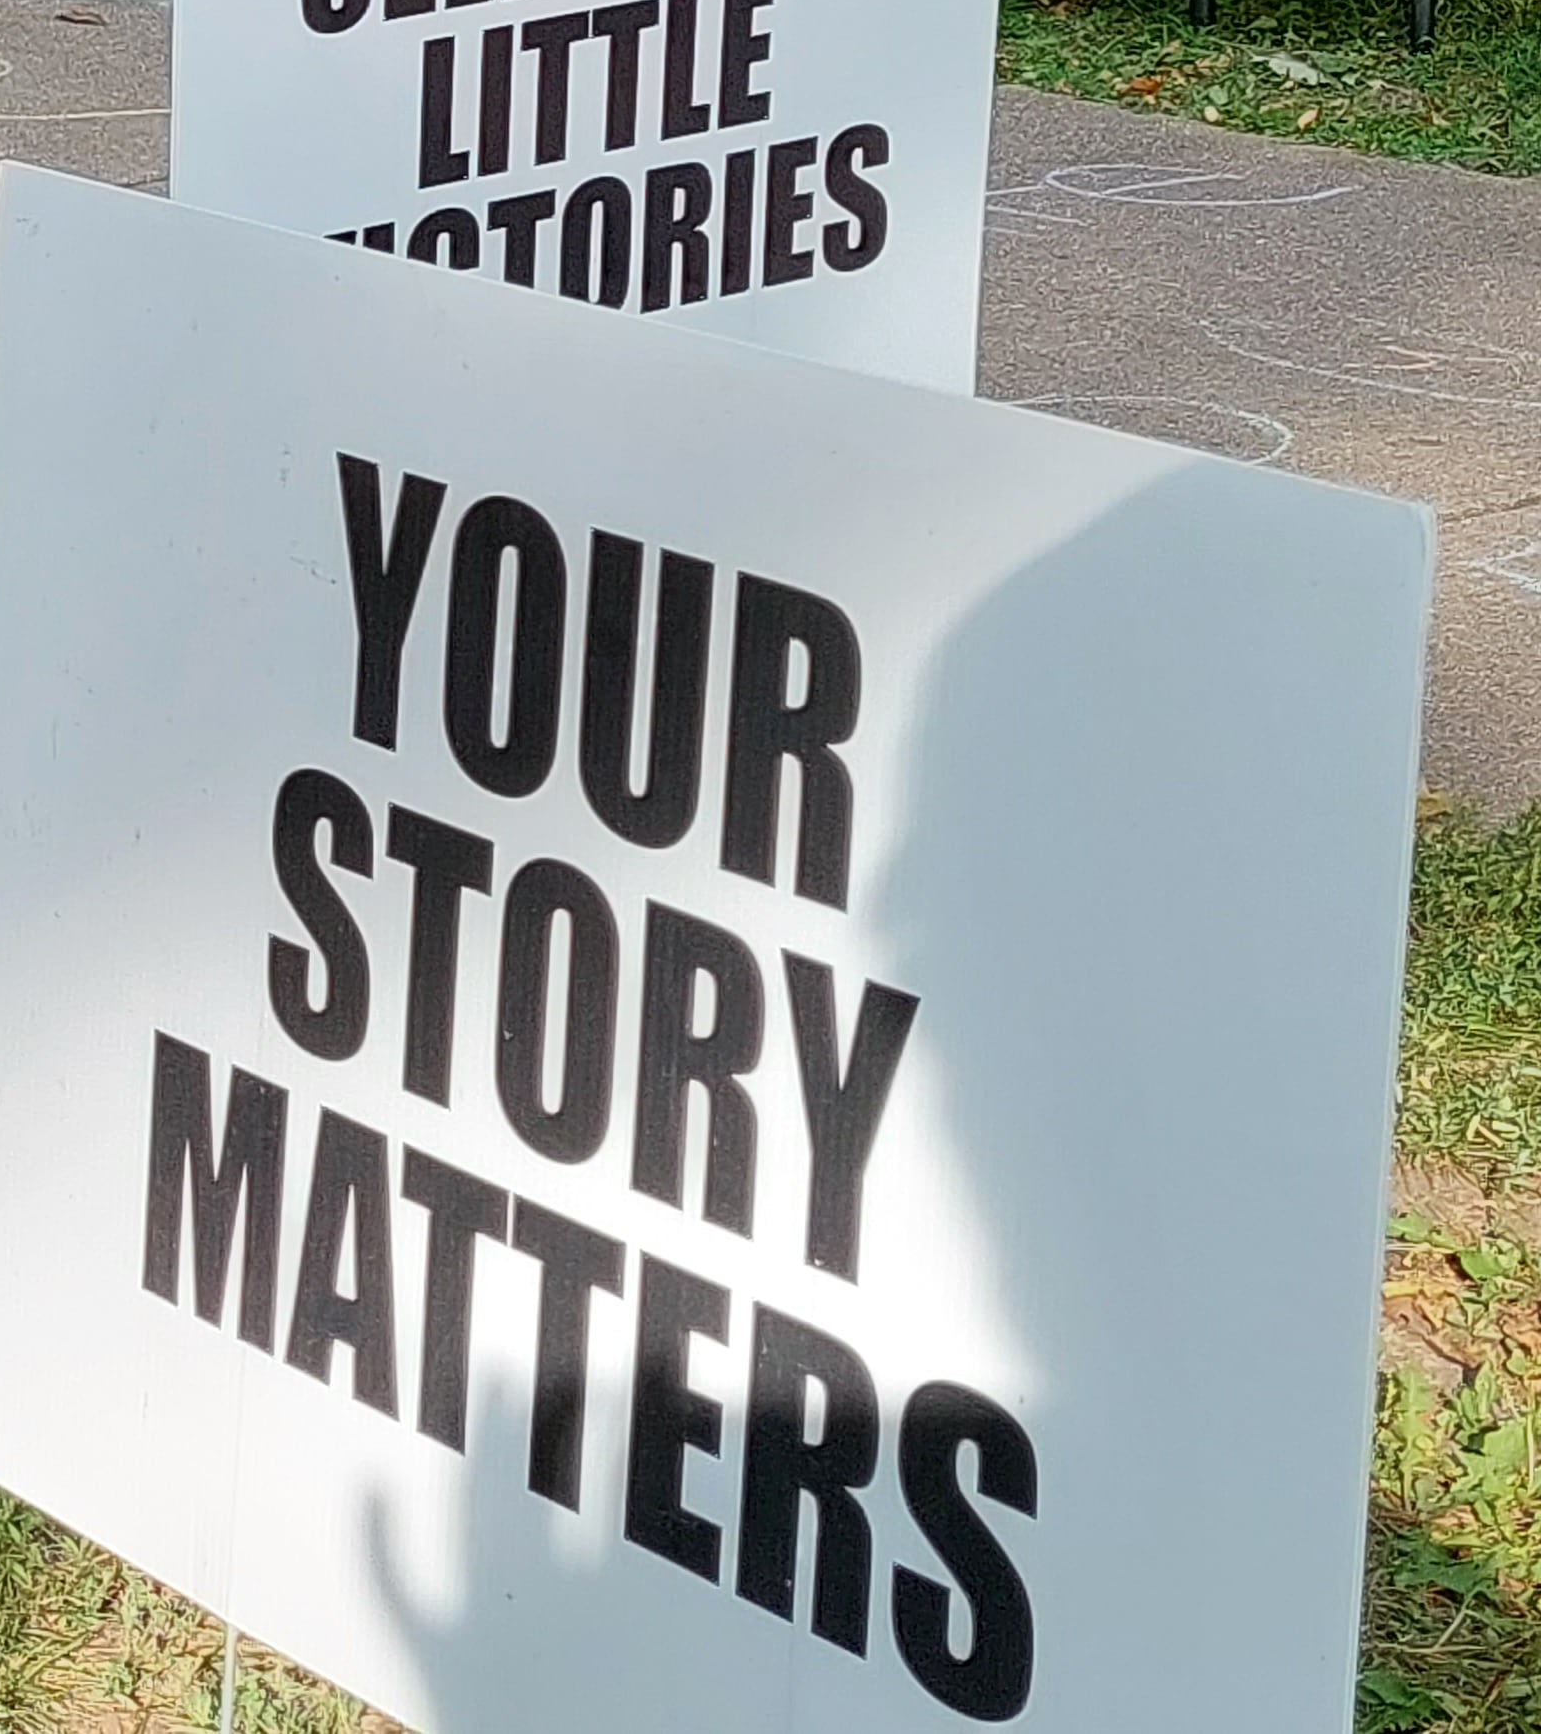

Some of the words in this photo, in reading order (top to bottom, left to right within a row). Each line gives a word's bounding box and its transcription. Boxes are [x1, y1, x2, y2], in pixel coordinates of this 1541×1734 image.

[334, 449, 863, 914] YOUR
[267, 766, 920, 1286] STORY
[141, 1026, 1038, 1725] MATTERS
